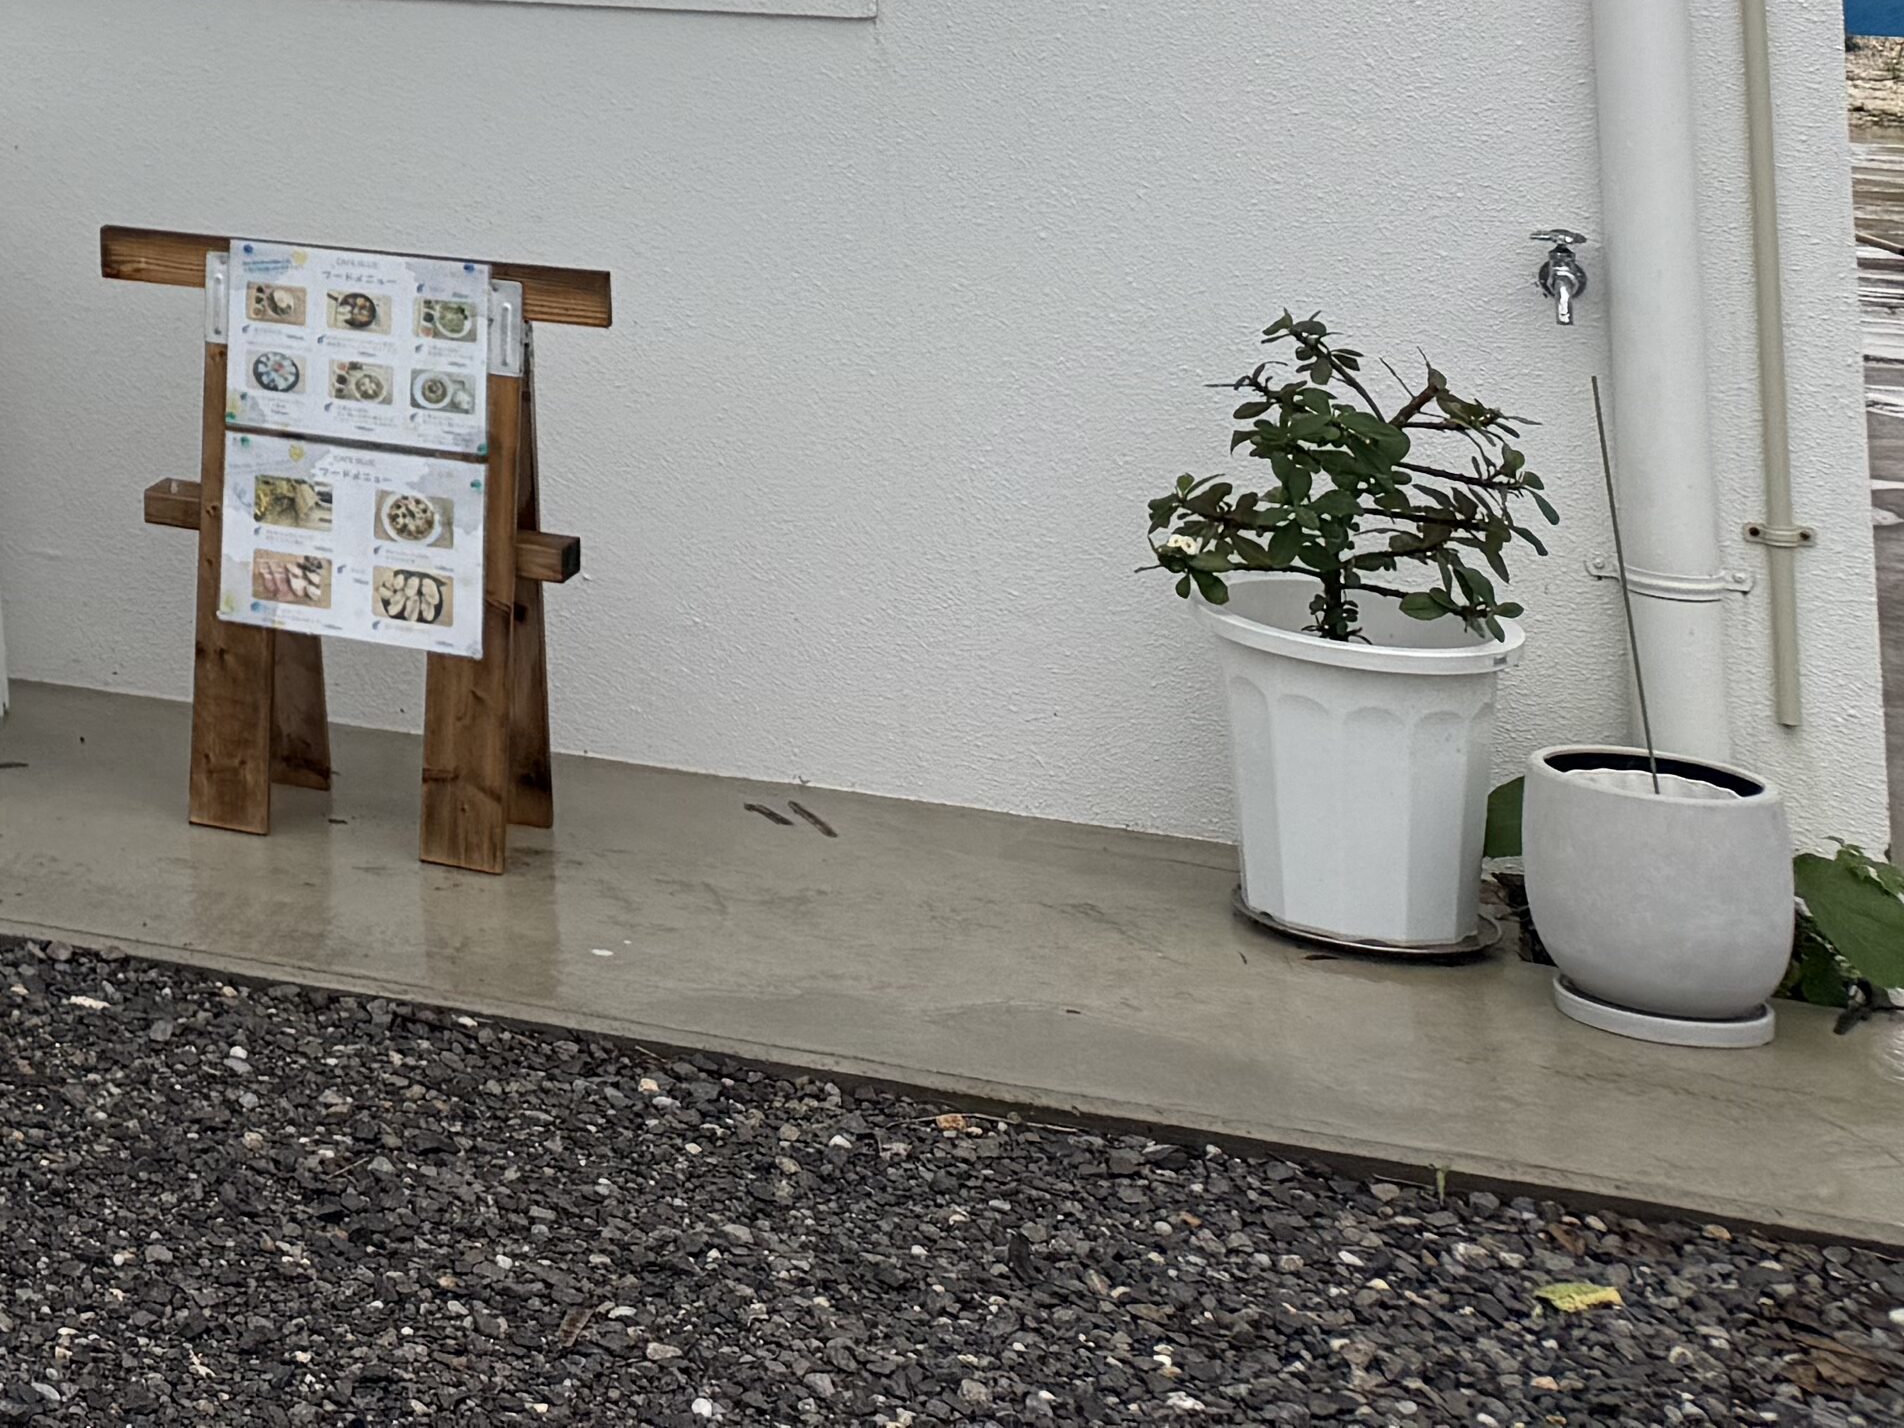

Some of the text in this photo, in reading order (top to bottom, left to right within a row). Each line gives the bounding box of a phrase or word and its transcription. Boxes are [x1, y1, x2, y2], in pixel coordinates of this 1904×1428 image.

[322, 270, 397, 285] フードメニュー
[318, 467, 393, 484] フードメニュー
